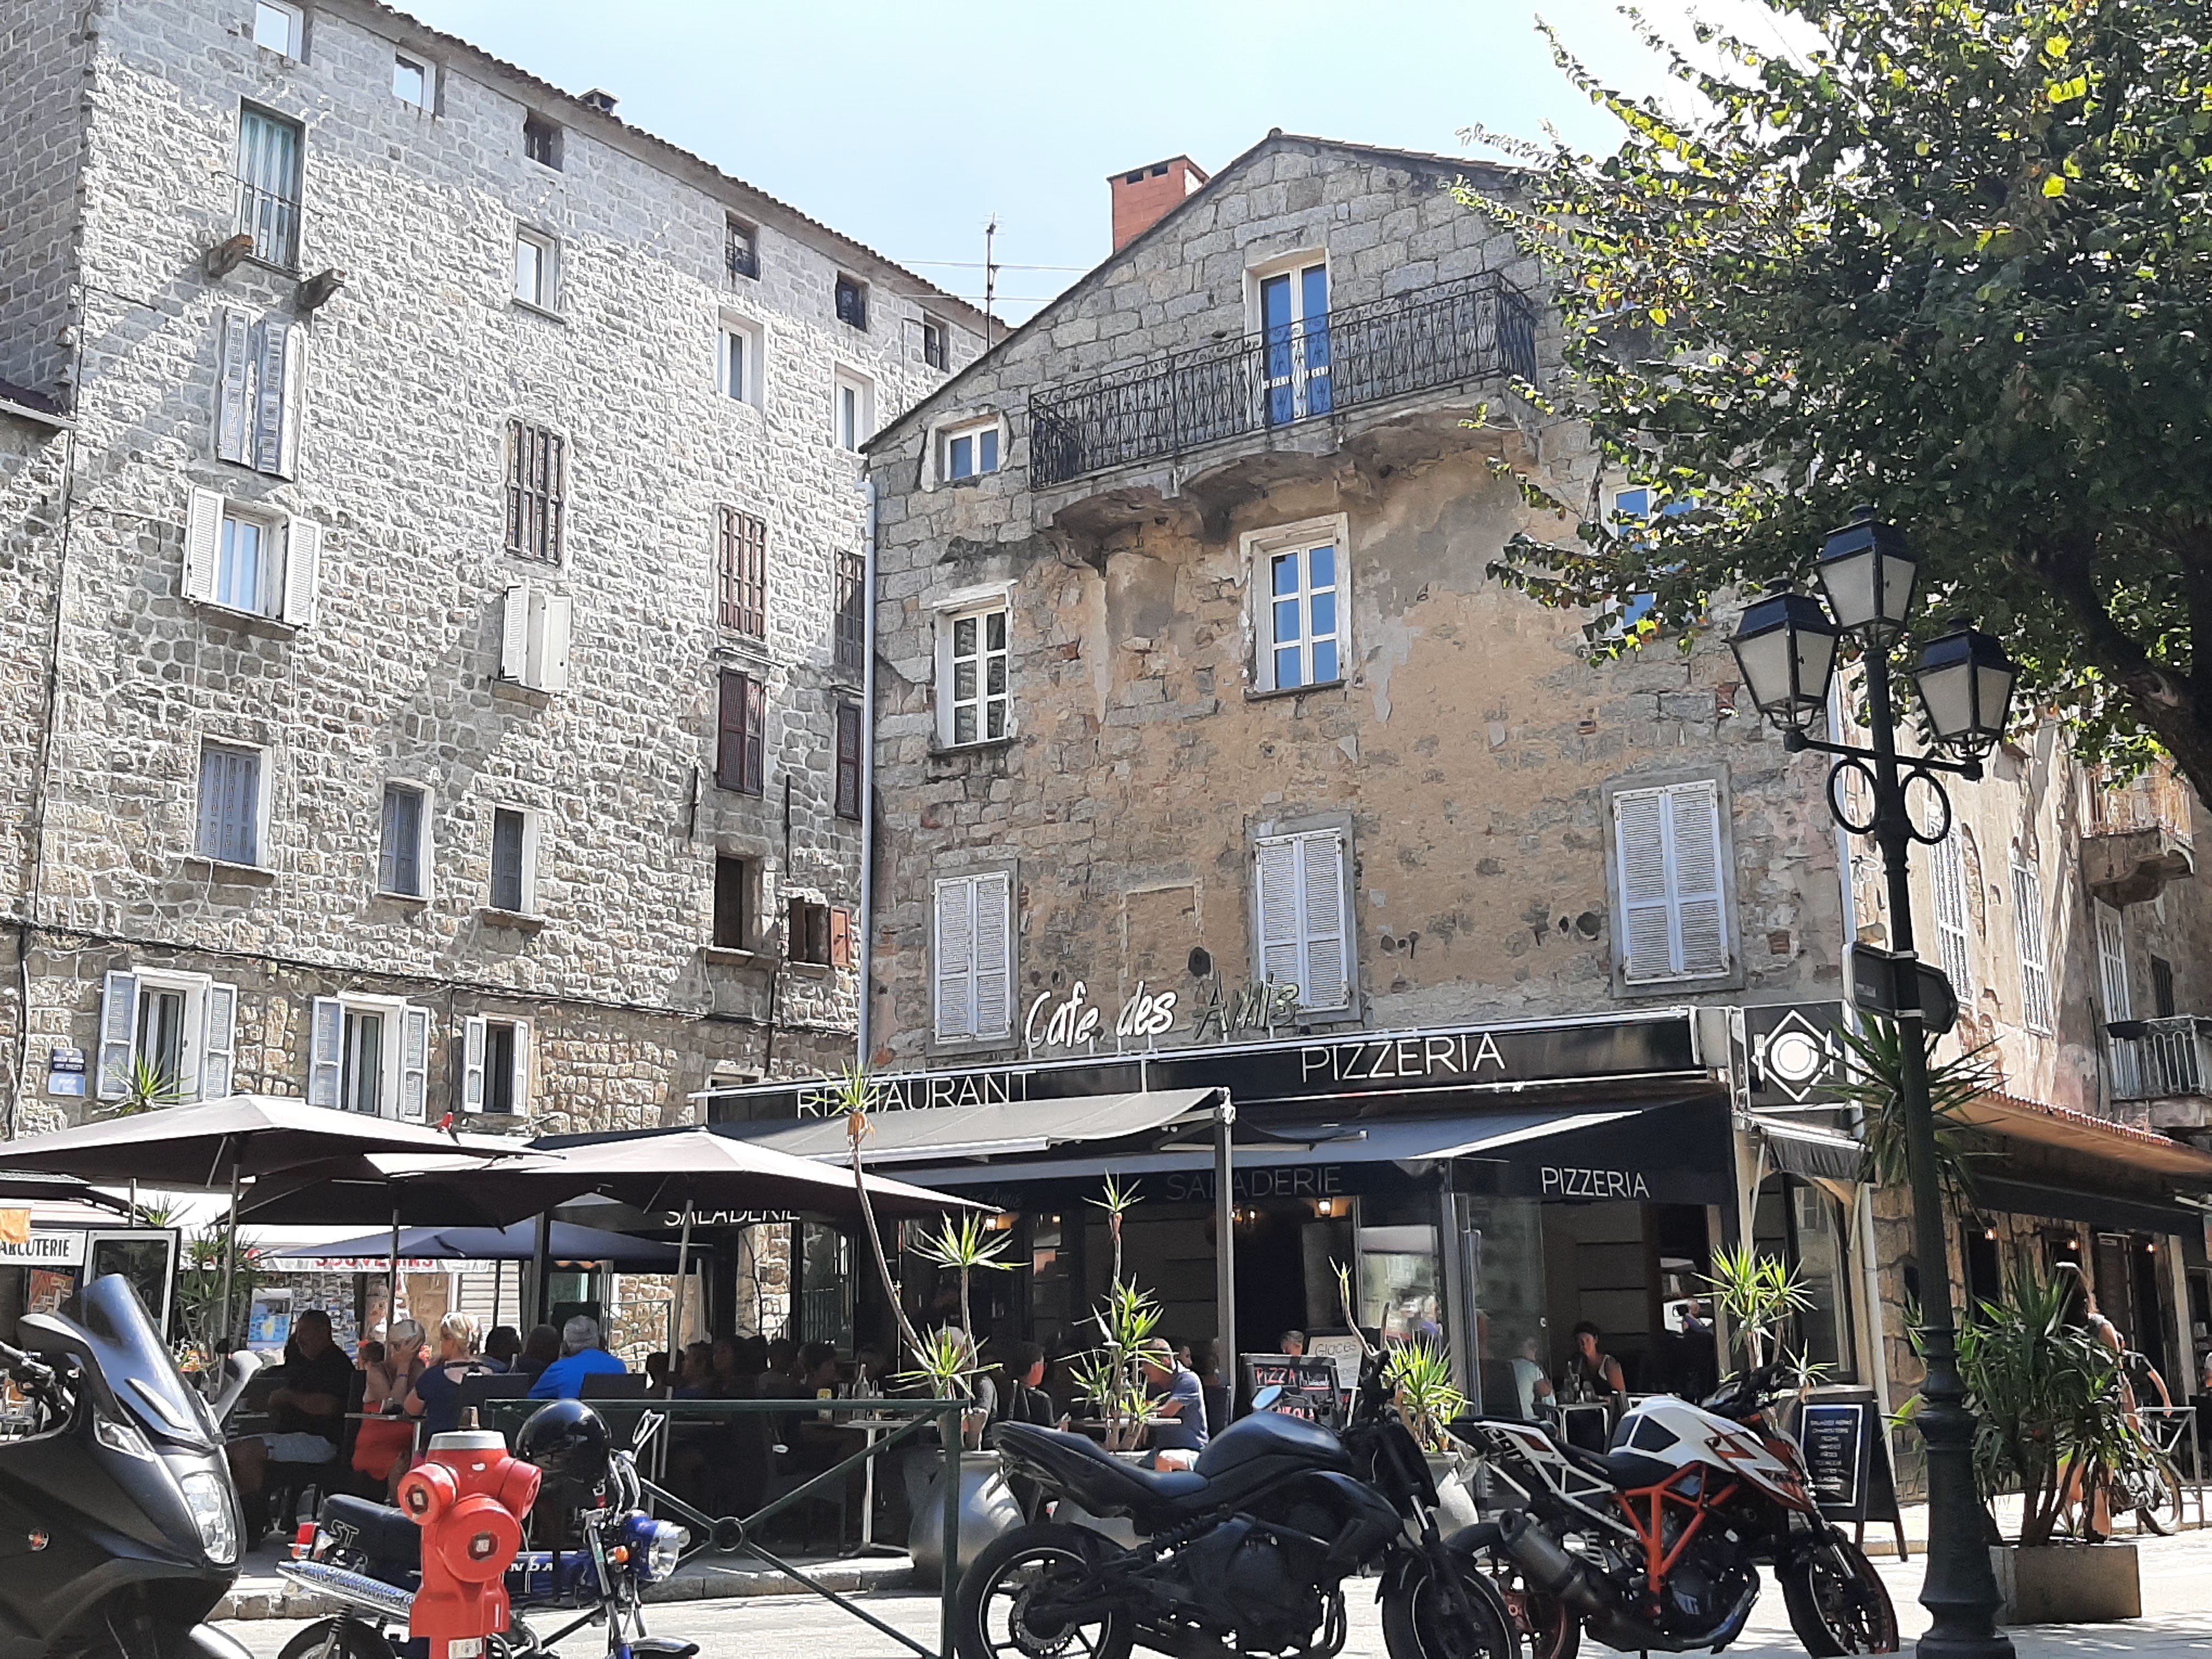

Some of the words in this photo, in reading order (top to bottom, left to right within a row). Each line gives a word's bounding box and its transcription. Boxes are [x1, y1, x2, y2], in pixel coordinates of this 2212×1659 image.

[1025, 979, 1099, 1048] Cafe
[1115, 980, 1177, 1037] des
[1301, 1032, 1506, 1083] PIZZERIA
[797, 1070, 1037, 1120] RETAURANT
[1541, 1166, 1651, 1199] PIZZERIA
[329, 1519, 360, 1548] ST
[509, 1562, 553, 1572] NDA
